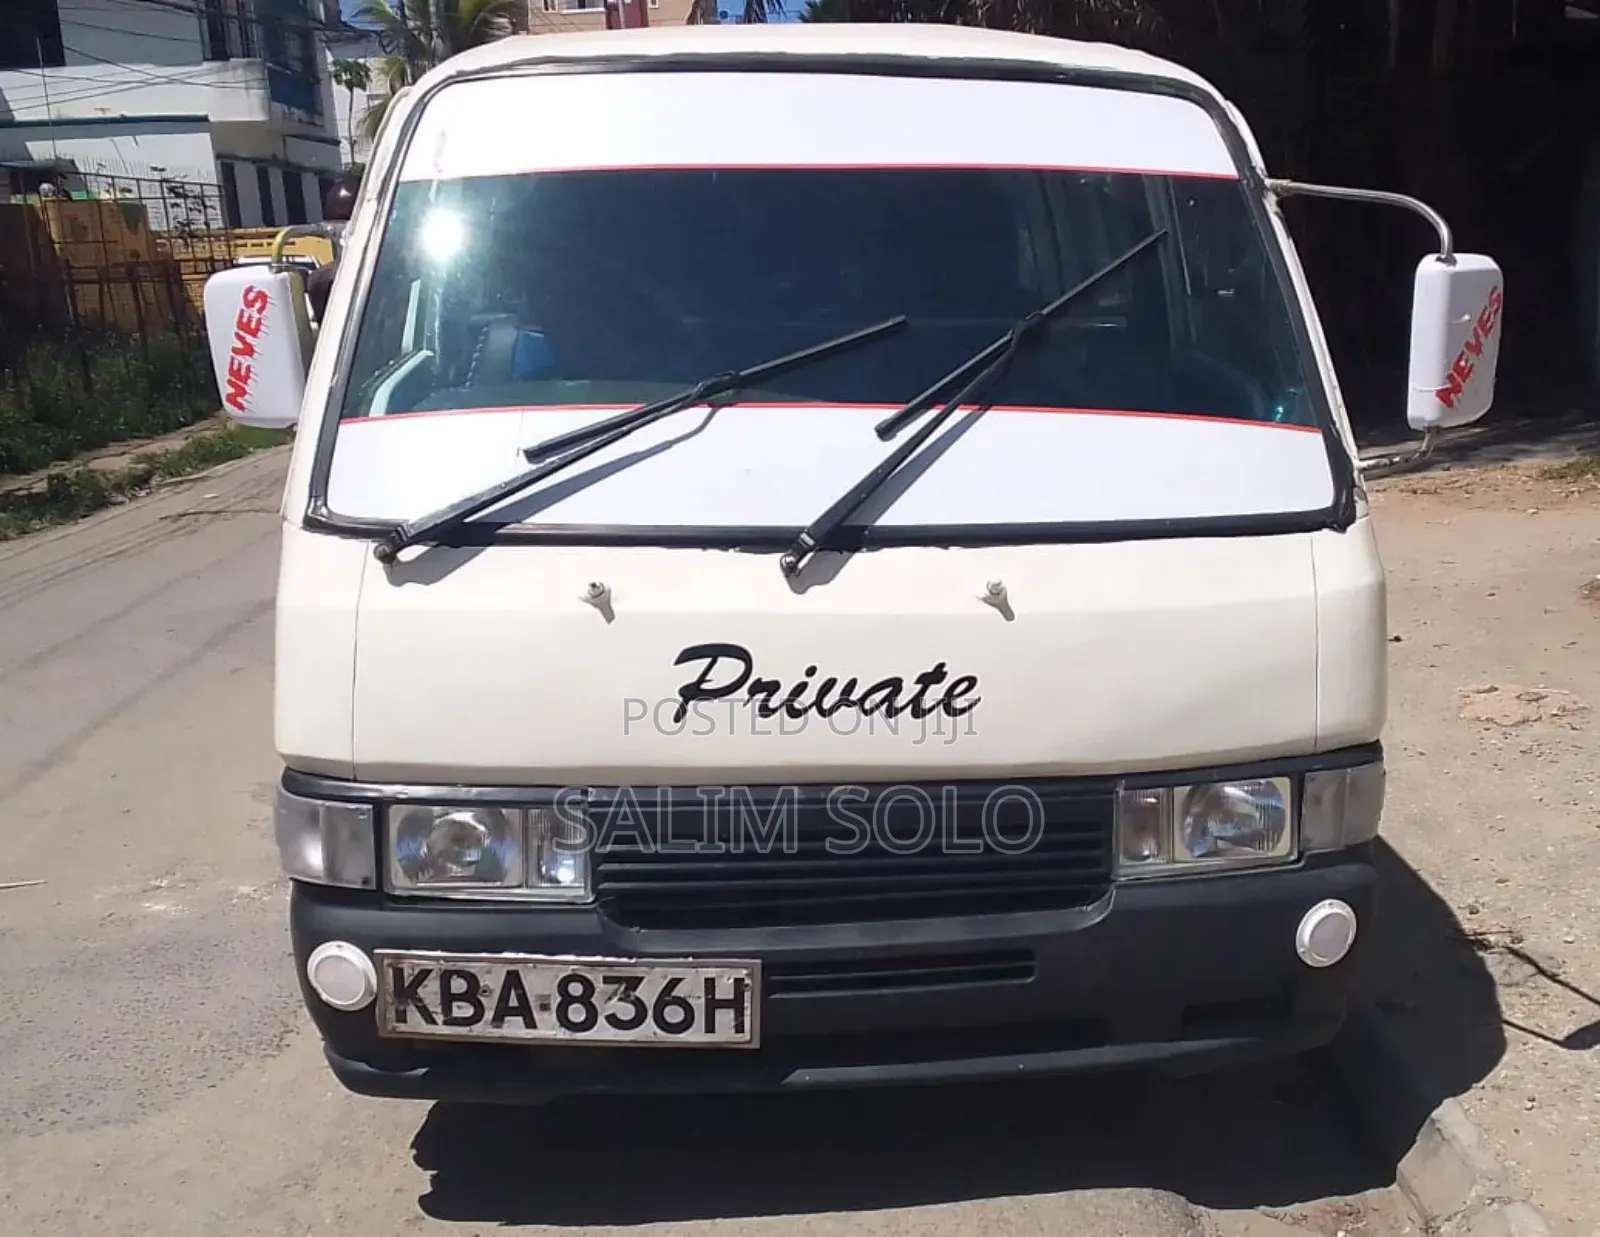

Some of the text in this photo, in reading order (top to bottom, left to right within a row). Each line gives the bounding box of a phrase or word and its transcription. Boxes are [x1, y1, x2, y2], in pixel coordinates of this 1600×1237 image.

[225, 285, 271, 412] NEVES
[1435, 285, 1502, 409] NEVES
[673, 642, 981, 724] Private
